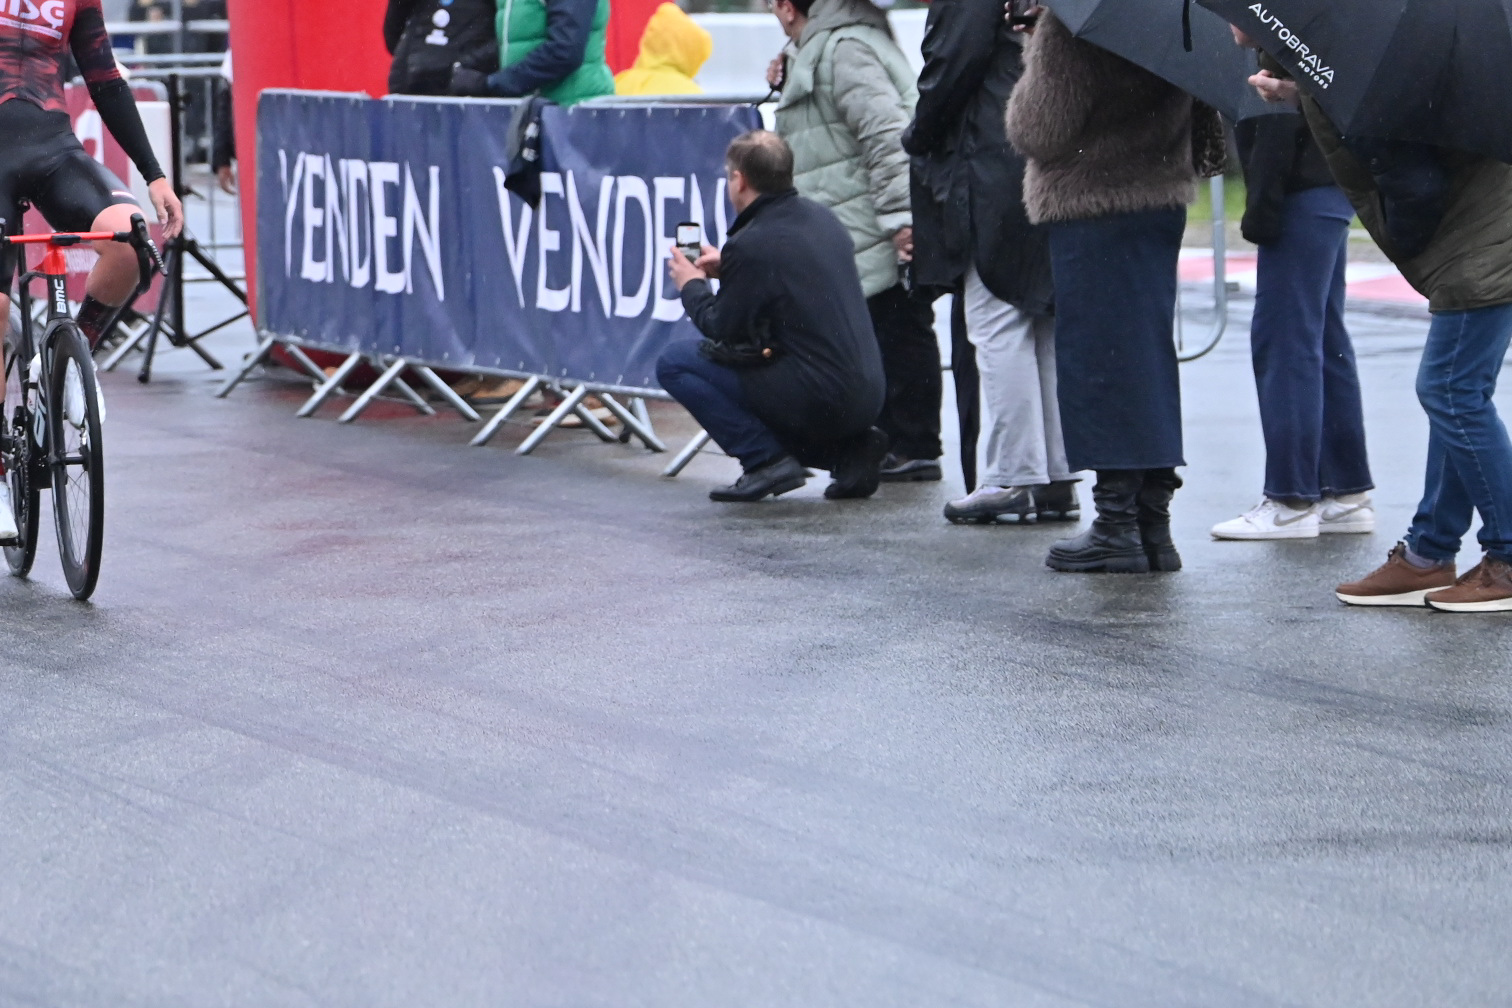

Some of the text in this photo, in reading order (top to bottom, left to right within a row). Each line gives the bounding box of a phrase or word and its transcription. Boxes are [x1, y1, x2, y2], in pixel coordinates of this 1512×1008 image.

[1248, 2, 1336, 84] AUTOBRAVA
[1297, 60, 1330, 90] MOTORS
[53, 278, 67, 314] BMC
